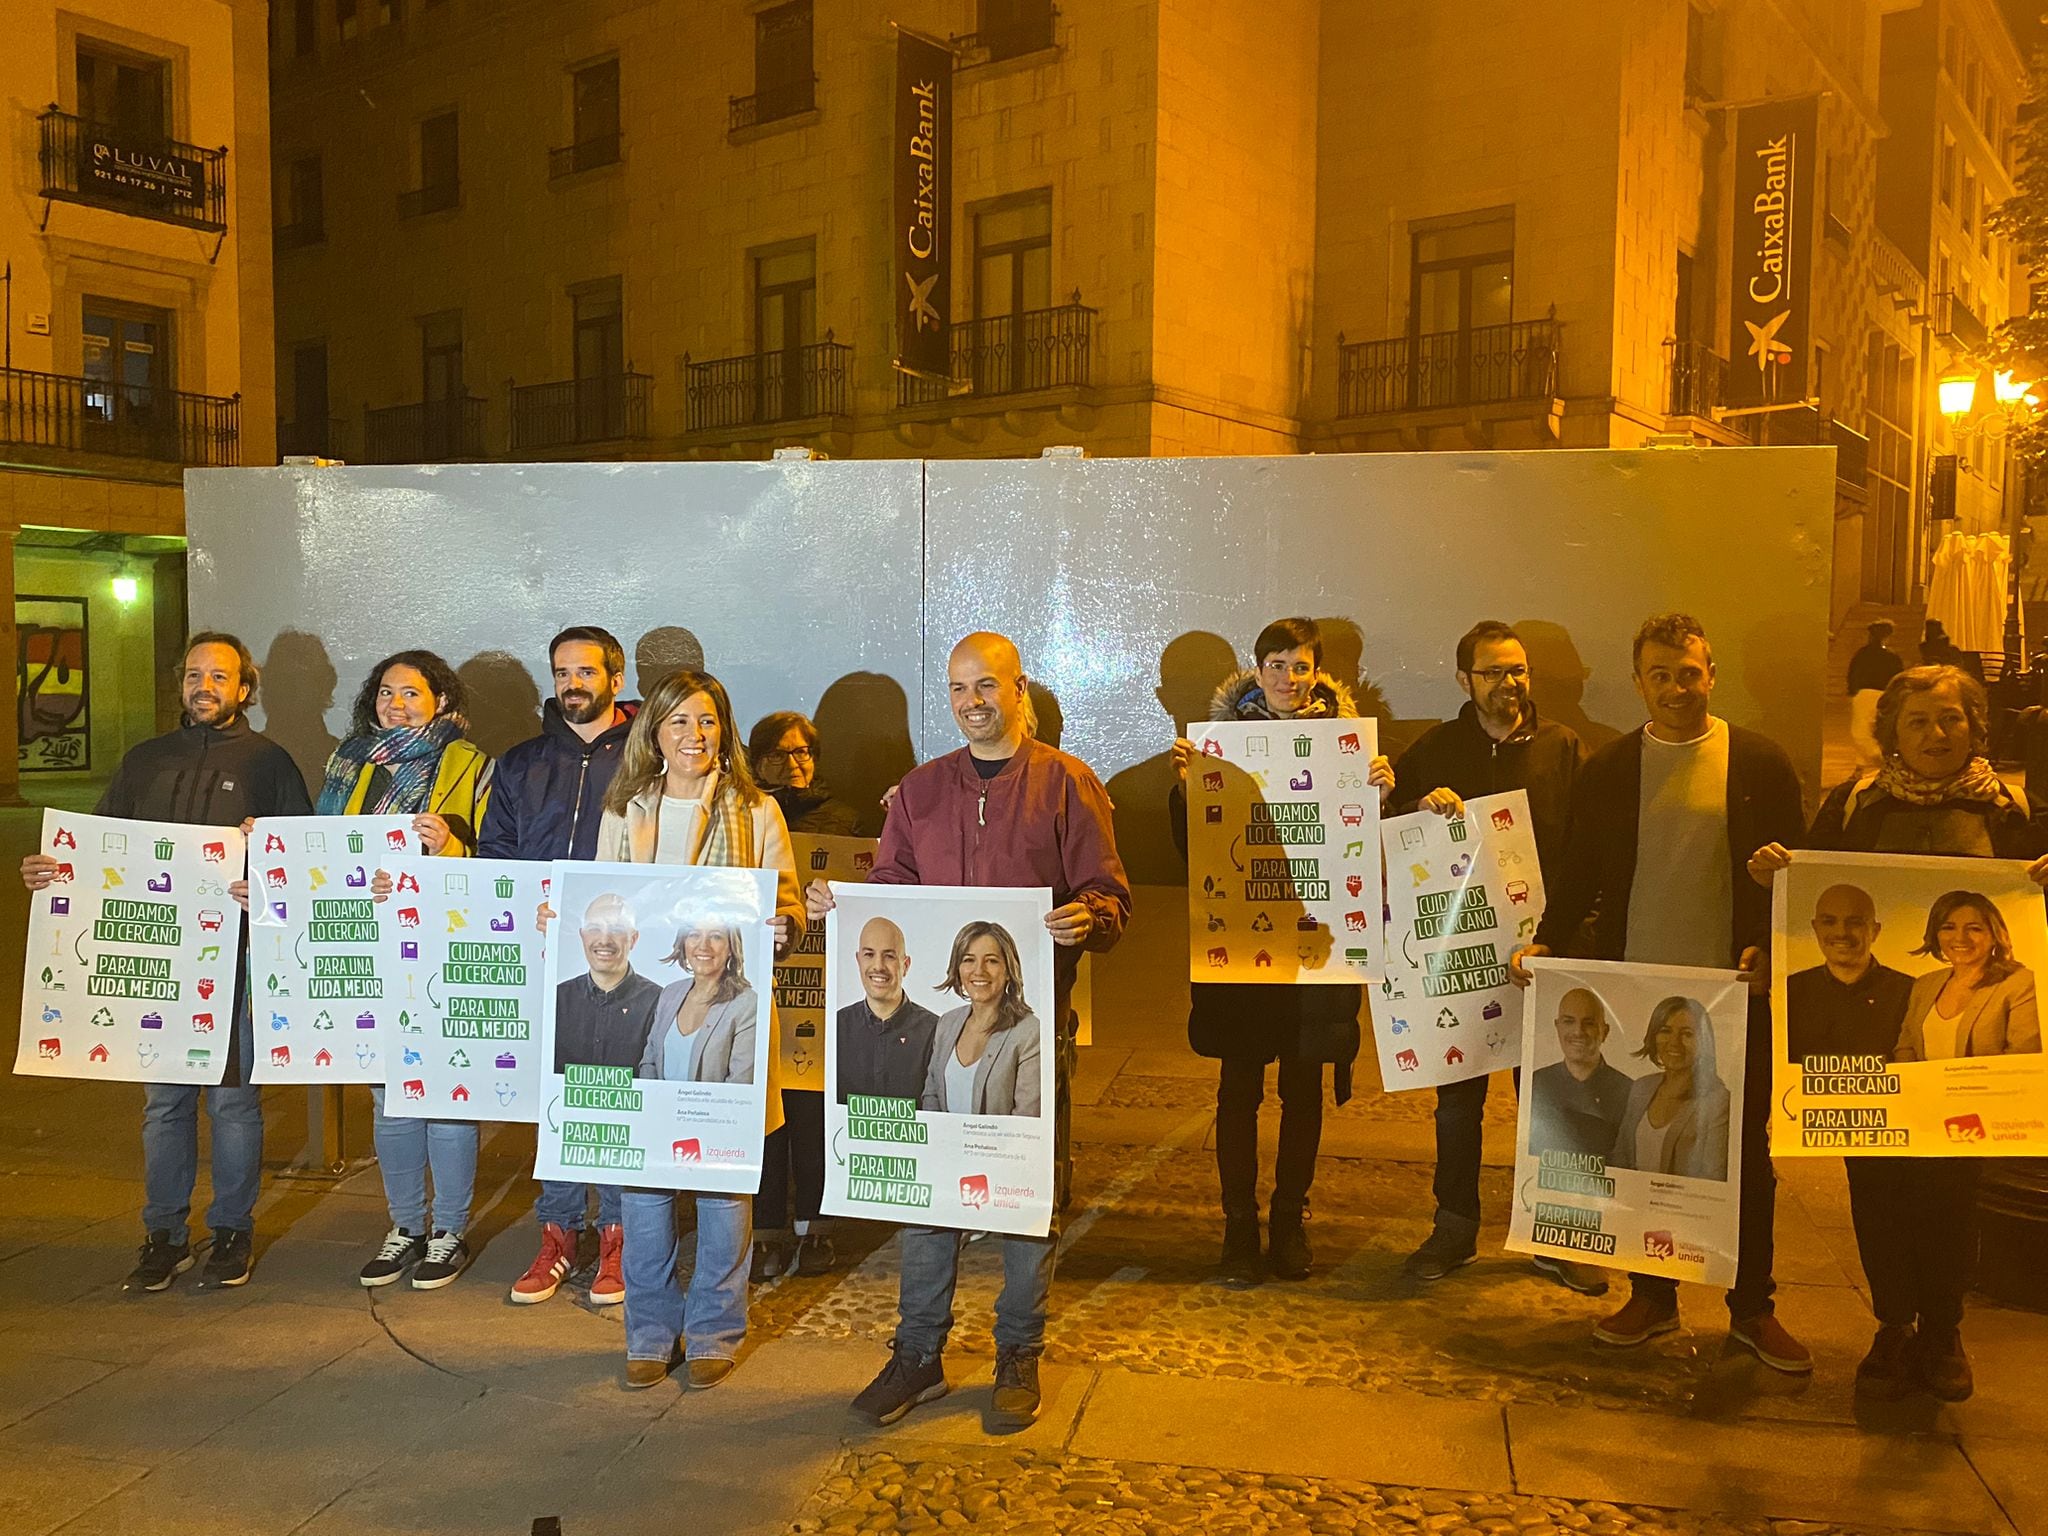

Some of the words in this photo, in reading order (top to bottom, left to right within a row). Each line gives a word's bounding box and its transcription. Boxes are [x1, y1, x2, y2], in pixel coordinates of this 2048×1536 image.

[909, 79, 933, 259] CaixaBank
[94, 169, 111, 179] 921
[115, 174, 127, 183] 46
[131, 178, 141, 186] 17
[143, 182, 156, 190] 26
[1750, 134, 1786, 303] CaixaBank
[1253, 803, 1317, 822] CUIDAMOS
[1249, 826, 1264, 844] LO
[1267, 825, 1323, 843] CERCANO
[1253, 860, 1287, 877] PARA
[1290, 860, 1317, 878] UNA
[1247, 882, 1280, 899] VIDA
[1284, 881, 1328, 899] MEJOR
[104, 900, 174, 922] CUIDAMOS
[314, 900, 372, 918] CUIDAMOS
[97, 922, 114, 939] LO
[118, 923, 178, 944] CERCANO
[311, 923, 325, 940] LO
[327, 923, 377, 940] CERCANO
[1417, 919, 1433, 938] LO
[451, 943, 519, 962] CUIDAMOS
[1427, 950, 1464, 975] PARA
[1464, 945, 1495, 967] UNA
[99, 956, 135, 975] PARA
[140, 959, 167, 977] UNA
[316, 957, 347, 975] PARA
[349, 957, 372, 975] UNA
[446, 965, 462, 982] LO
[465, 965, 524, 984] CERCANO
[794, 969, 819, 985] UNA
[1424, 974, 1461, 996] VIDA
[1462, 966, 1508, 990] MEJOR
[90, 977, 126, 995] VIDA
[129, 980, 176, 999] MEJOR
[310, 979, 341, 997] VIDA
[344, 979, 382, 997] MEJOR
[451, 998, 485, 1016] PARA
[489, 1000, 516, 1017] UNA
[444, 1019, 478, 1037] VIDA
[482, 1021, 527, 1038] MEJOR
[1805, 1055, 1884, 1073] CUIDAMOS
[567, 1065, 631, 1087] CUIDAMOS
[1806, 1077, 1825, 1094] LO
[1828, 1075, 1899, 1094] CERCANO
[567, 1088, 582, 1106] LO
[585, 1089, 640, 1110] CERCANO
[849, 1096, 914, 1118] CUIDAMOS
[1806, 1110, 1847, 1128] PARA
[1851, 1109, 1885, 1127] UNA
[565, 1122, 598, 1142] PARA
[602, 1125, 627, 1144] UNA
[851, 1120, 867, 1138] LO
[870, 1121, 927, 1143] CERCANO
[1804, 1131, 1847, 1147] VIDA
[1850, 1130, 1908, 1146] MEJOR
[563, 1145, 595, 1166] VIDA
[598, 1148, 643, 1169] MEJOR
[706, 1146, 746, 1158] izquierda
[1541, 1149, 1603, 1173] CUIDAMOS
[852, 1155, 885, 1177] PARA
[888, 1158, 914, 1179] UNA
[1541, 1170, 1556, 1188] LO
[850, 1179, 882, 1200] VIDA
[885, 1182, 930, 1206] MEJOR
[994, 1184, 1034, 1197] izquierda
[1537, 1203, 1570, 1225] PARA
[1573, 1209, 1599, 1229] UNA
[1535, 1224, 1566, 1245] VIDA
[1569, 1230, 1613, 1254] MEJOR
[1678, 1252, 1704, 1263] unida
